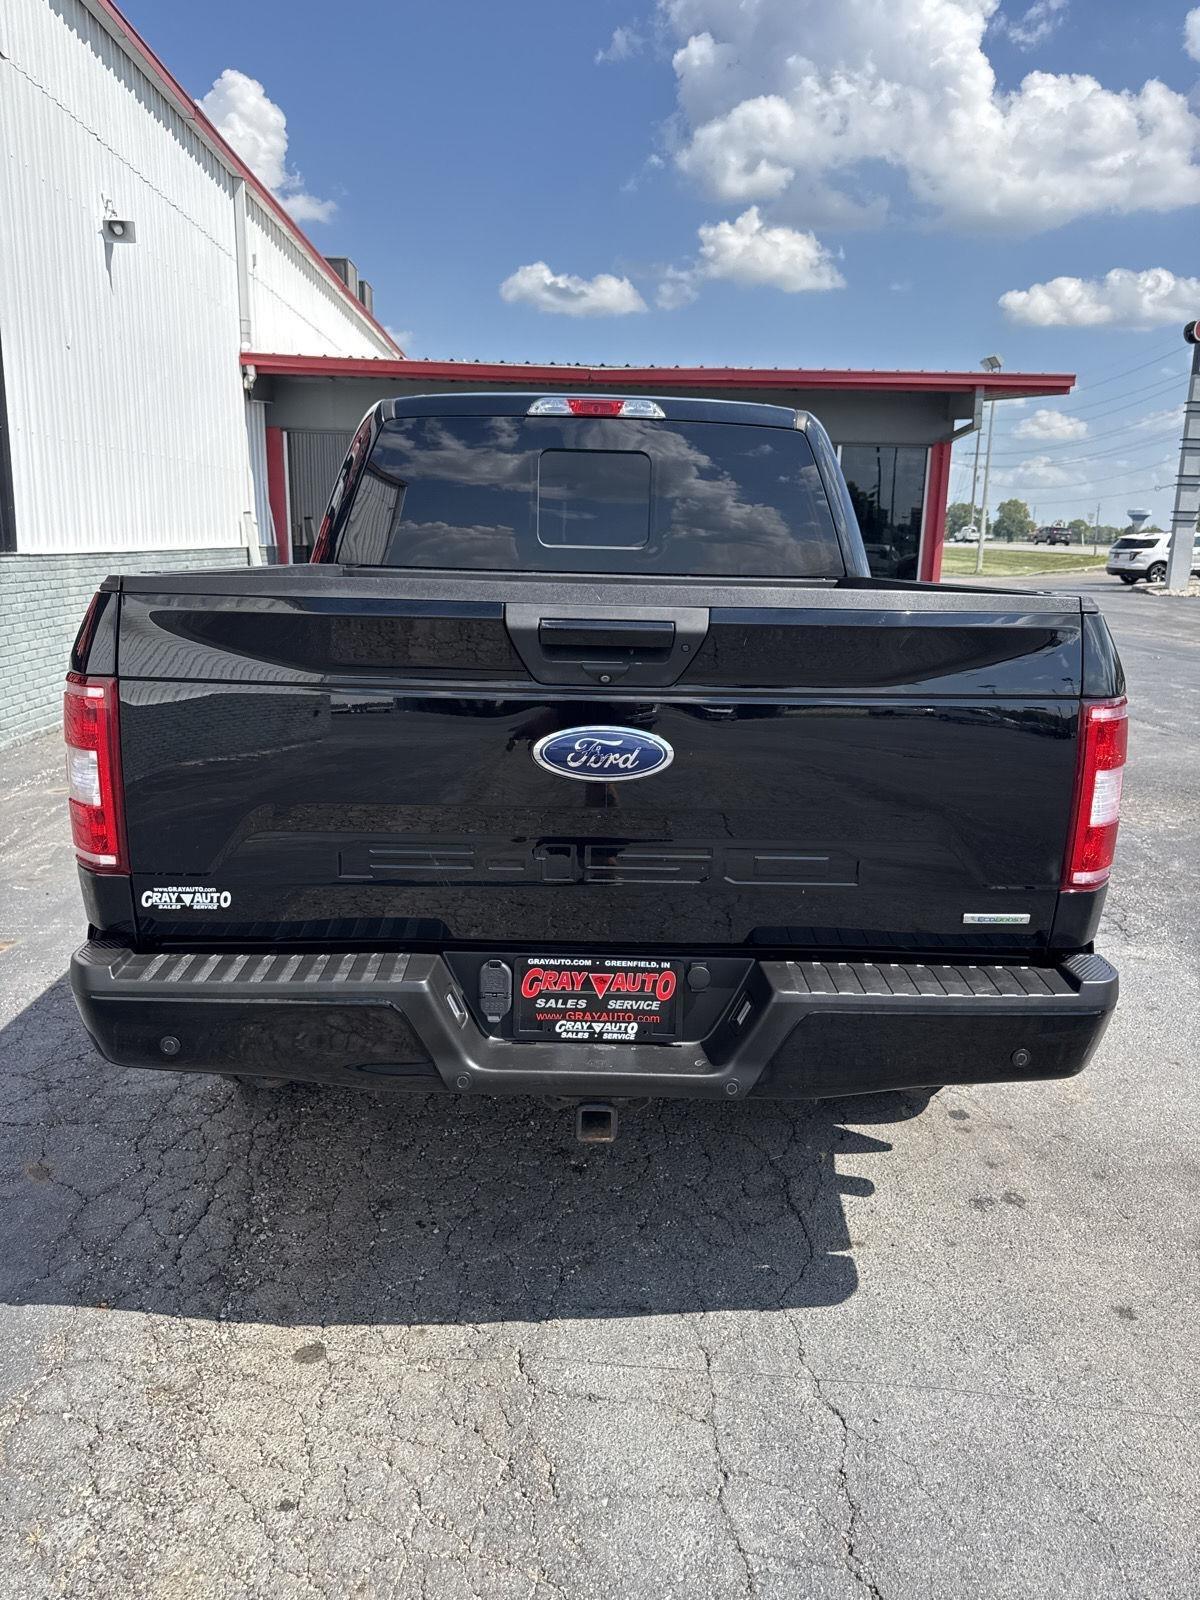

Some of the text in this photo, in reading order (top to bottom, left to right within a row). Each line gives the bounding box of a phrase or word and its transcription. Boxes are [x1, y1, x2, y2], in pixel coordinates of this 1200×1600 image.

[566, 737, 642, 769] Ford
[141, 890, 232, 908] GRAY AUTO
[527, 958, 671, 969] GRAYAUTO.COM GREENFIELD, IN
[521, 967, 588, 999] GRAY
[610, 970, 677, 1001] AUTO
[535, 998, 661, 1011] SALES SERVICE
[555, 1020, 638, 1034] GRAY AUTO
